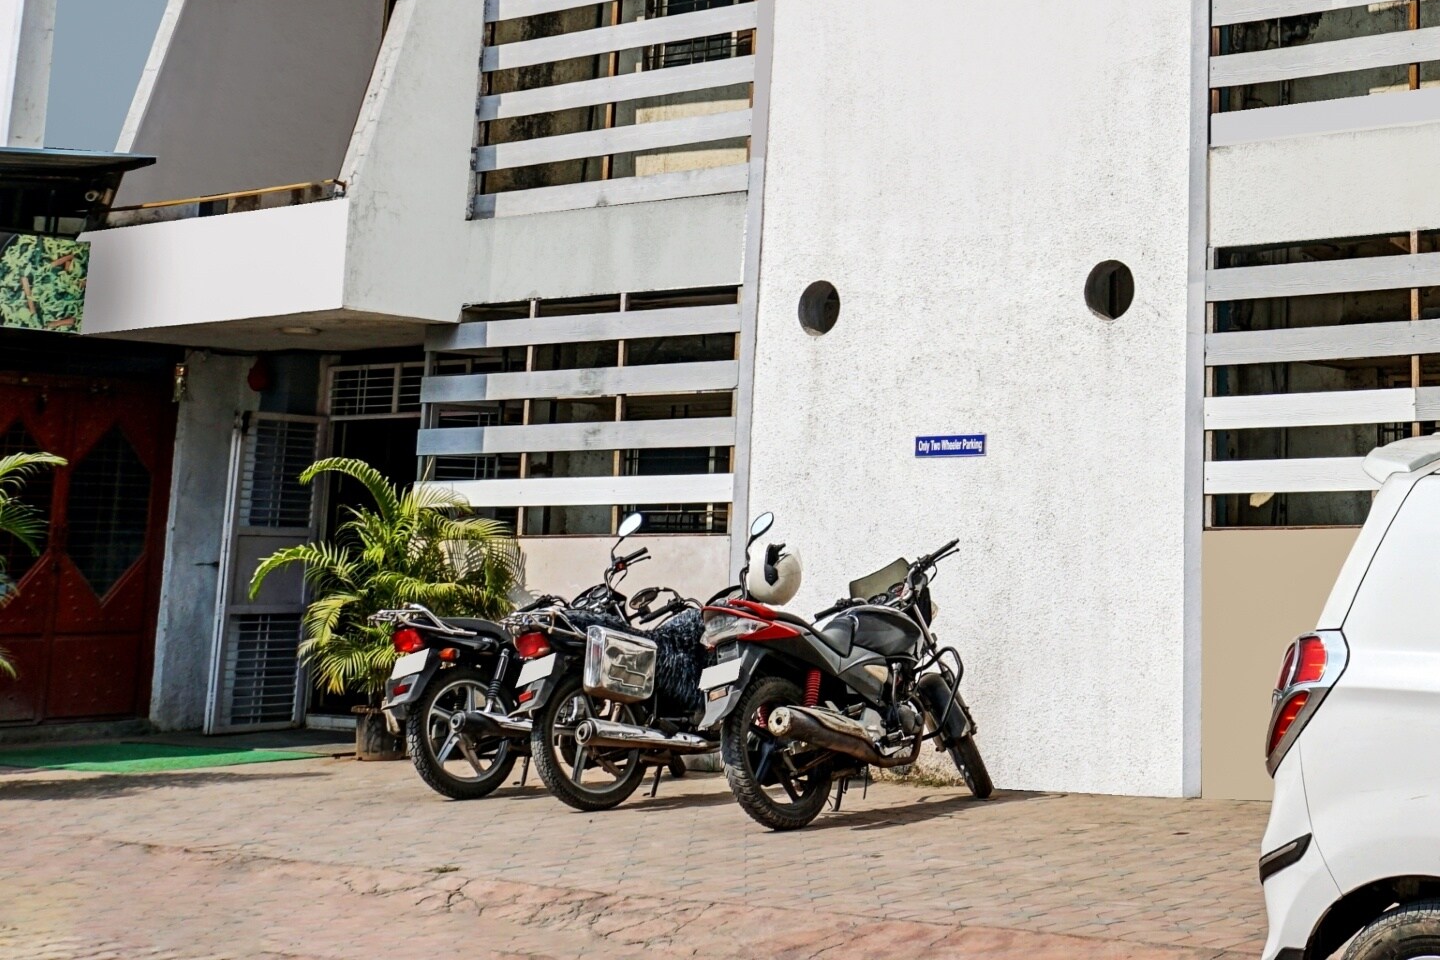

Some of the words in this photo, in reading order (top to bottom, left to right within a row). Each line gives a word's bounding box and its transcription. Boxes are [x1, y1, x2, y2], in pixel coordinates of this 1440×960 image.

[918, 440, 930, 454] Only
[931, 440, 940, 451] Two
[941, 439, 962, 450] Wheeler
[963, 439, 983, 452] Parking
